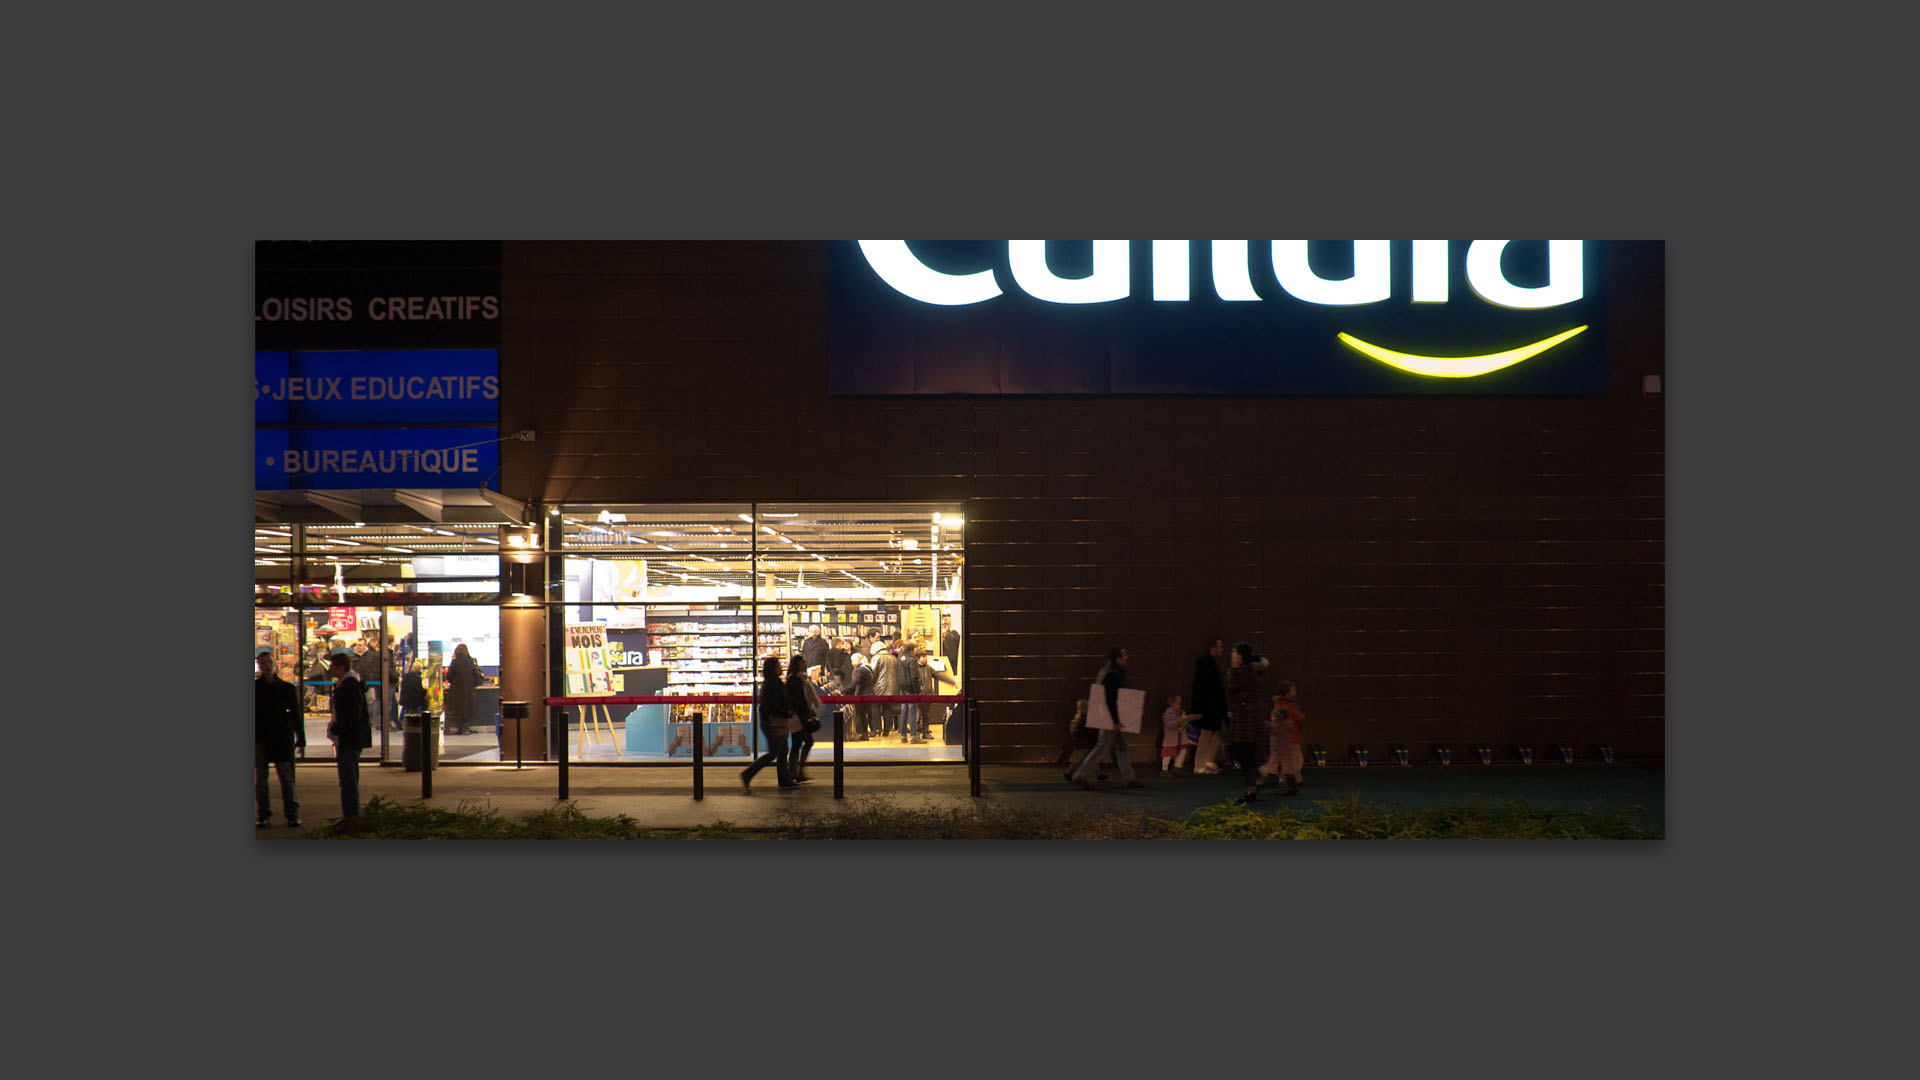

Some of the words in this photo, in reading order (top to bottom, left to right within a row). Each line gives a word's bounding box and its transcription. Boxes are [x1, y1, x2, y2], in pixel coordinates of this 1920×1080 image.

[368, 296, 499, 320] CREATIFS
[272, 377, 342, 401] JEUX
[351, 376, 499, 400] EDUCATIFS
[283, 449, 478, 474] BUREAUTIQUE
[571, 634, 603, 648] MOIS
